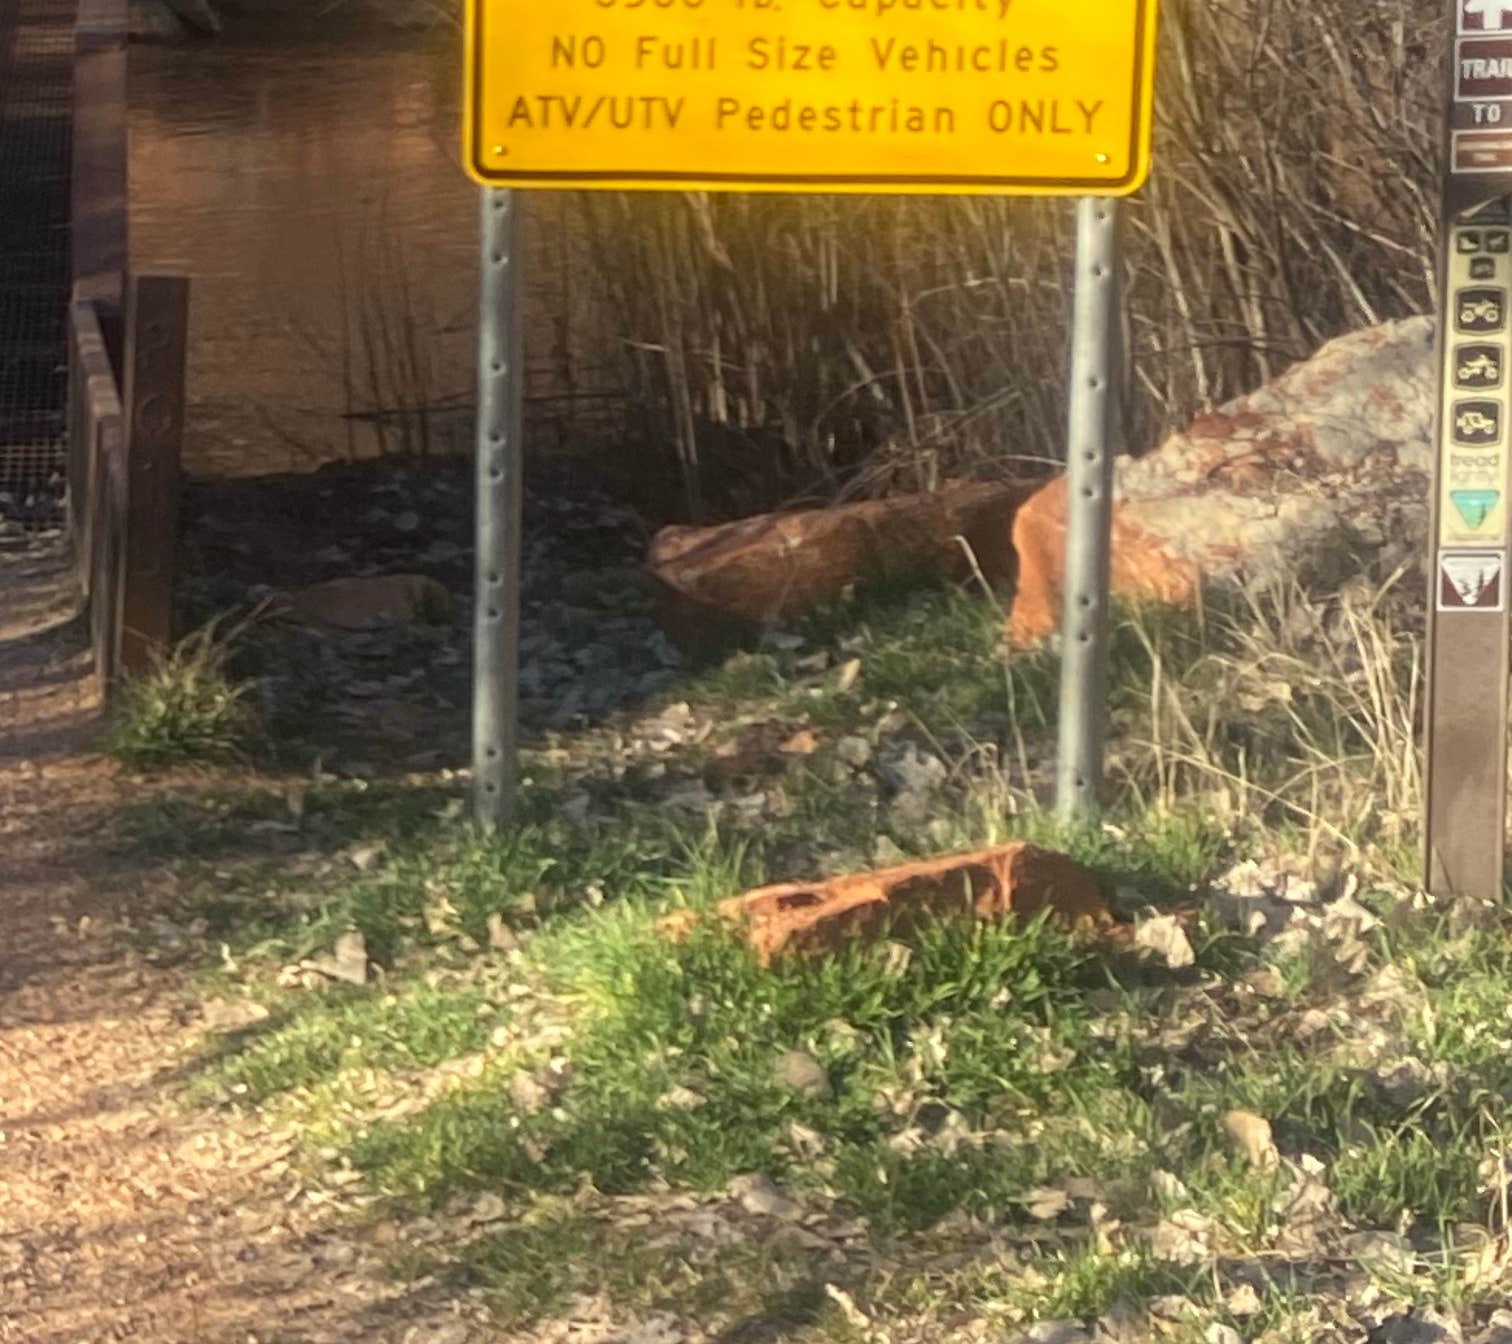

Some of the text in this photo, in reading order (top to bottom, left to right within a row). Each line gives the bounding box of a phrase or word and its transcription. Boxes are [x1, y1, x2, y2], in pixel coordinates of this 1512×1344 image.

[551, 36, 1059, 72] NO Full Size Vehicles
[507, 97, 1105, 135] ATV/UTV Pedestrian ONLY
[1473, 104, 1501, 124] TO
